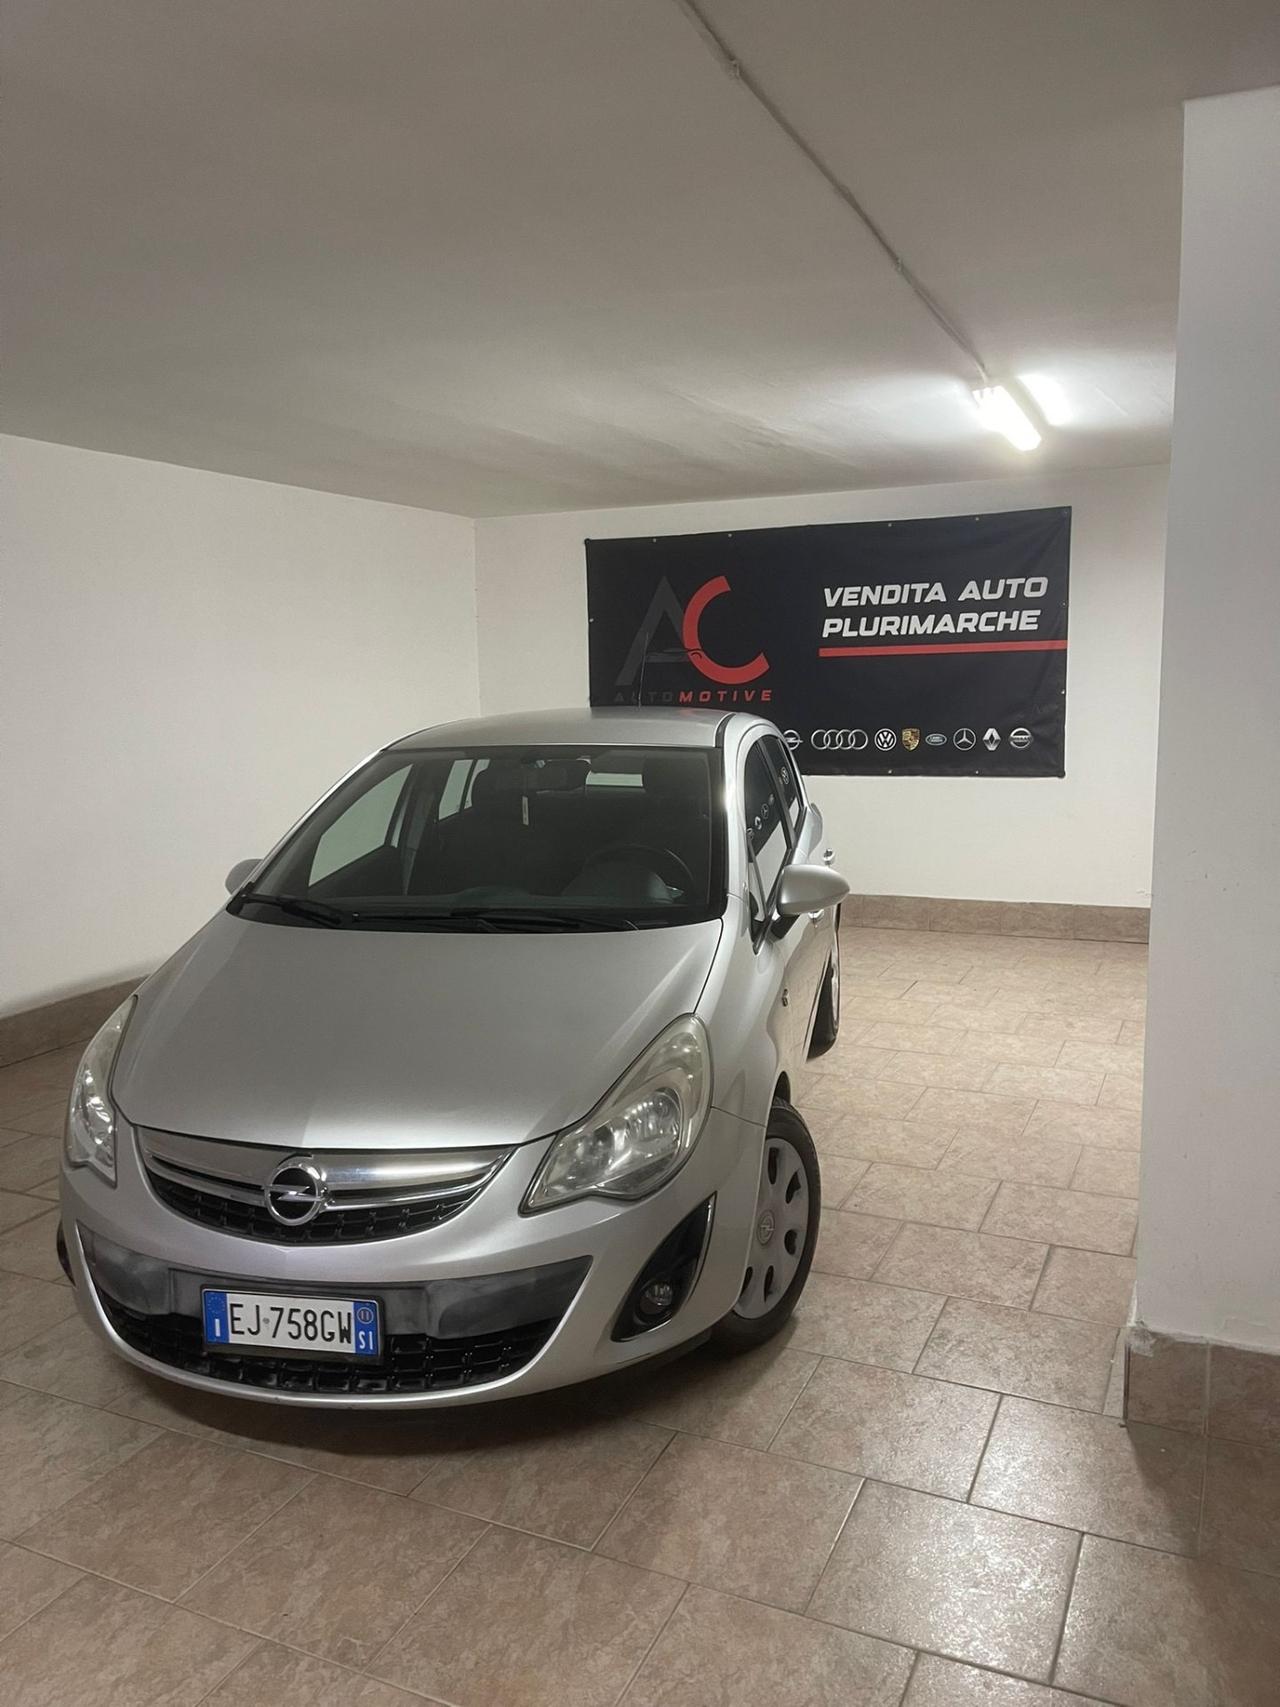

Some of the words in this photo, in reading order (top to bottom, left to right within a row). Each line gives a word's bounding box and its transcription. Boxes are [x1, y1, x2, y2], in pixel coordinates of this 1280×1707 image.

[824, 582, 947, 607] VENDITA
[958, 576, 1049, 601] AUTO
[822, 609, 1042, 638] PLURIMARCHE
[358, 1330, 374, 1350] SI
